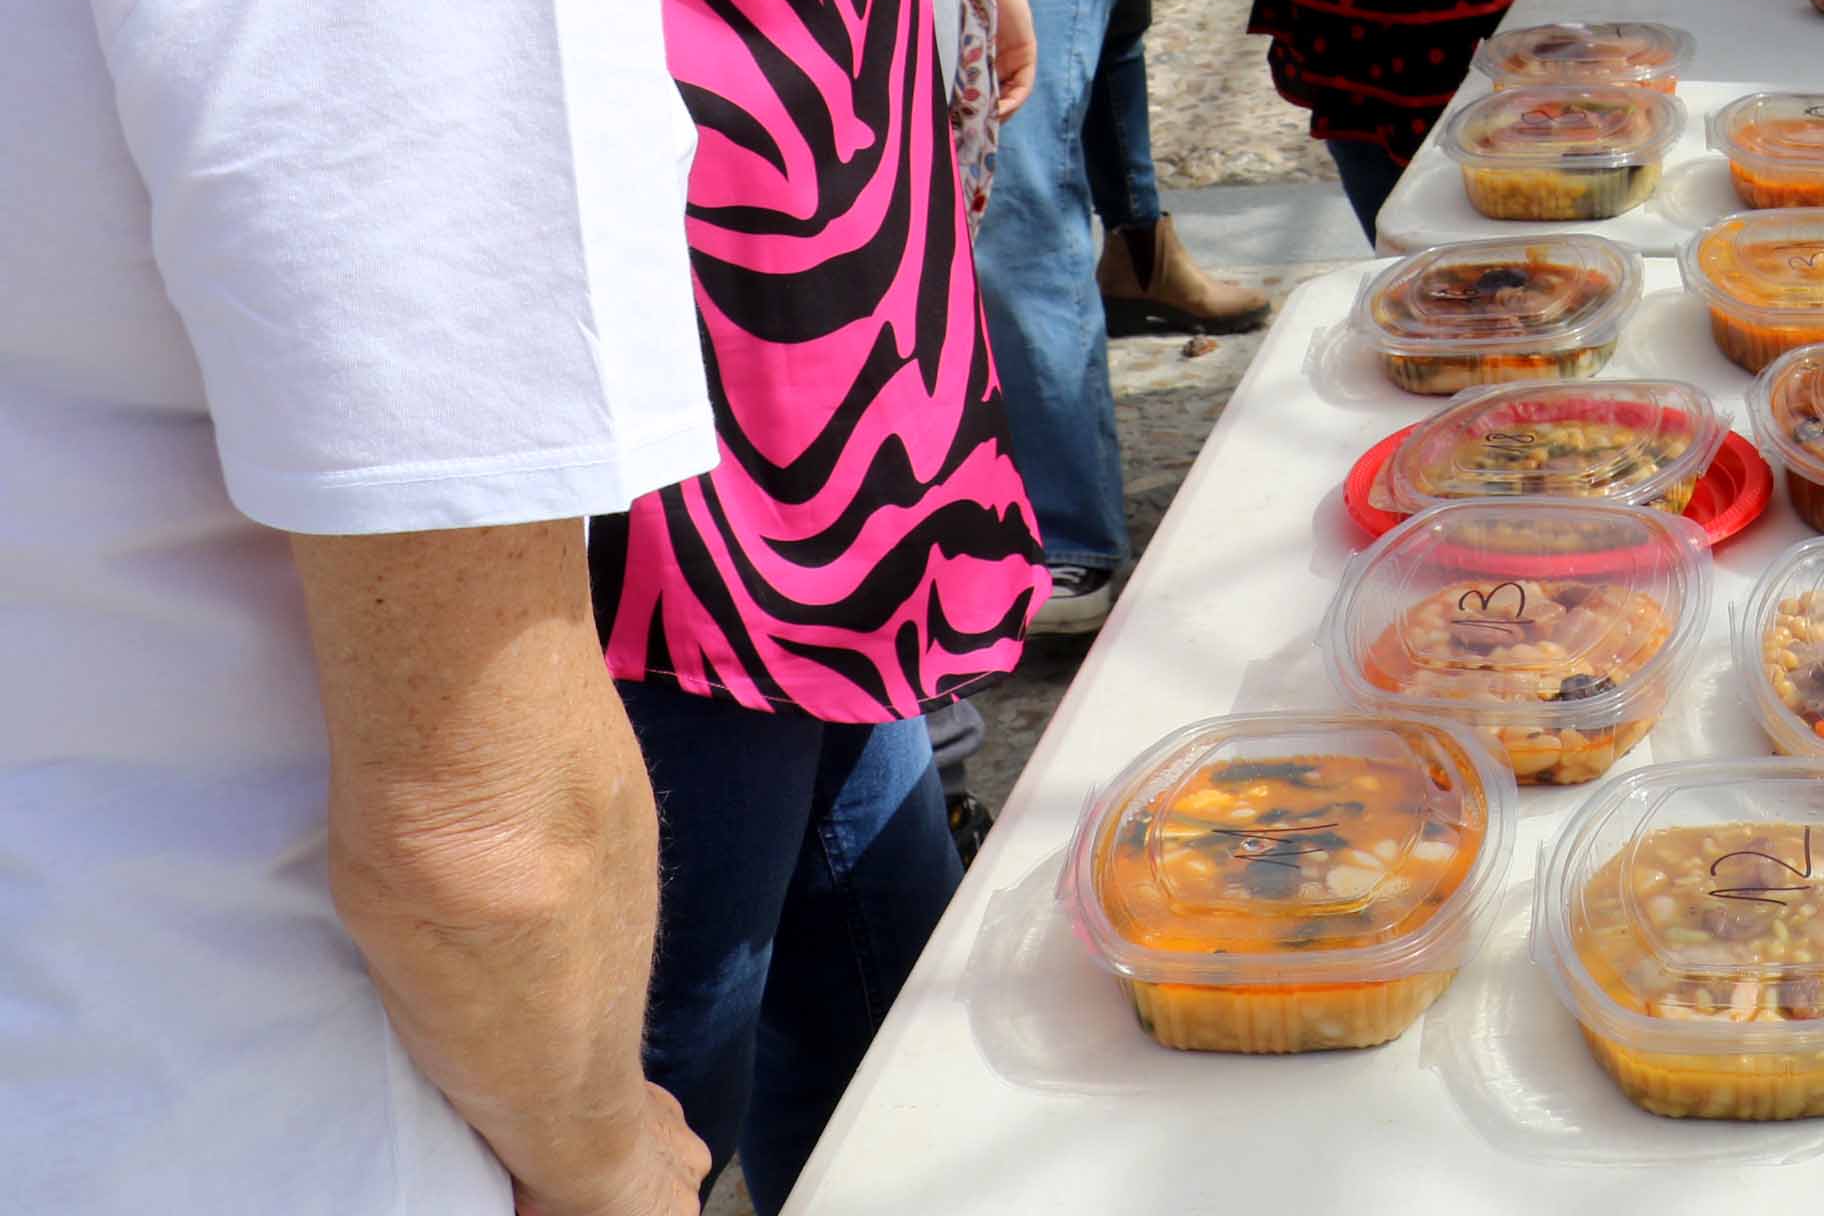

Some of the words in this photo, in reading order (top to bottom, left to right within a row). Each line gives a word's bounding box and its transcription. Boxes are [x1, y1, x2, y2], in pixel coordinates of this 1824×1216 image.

[1482, 432, 1538, 455] 18
[1451, 581, 1535, 634] 13
[1708, 824, 1813, 907] 12
